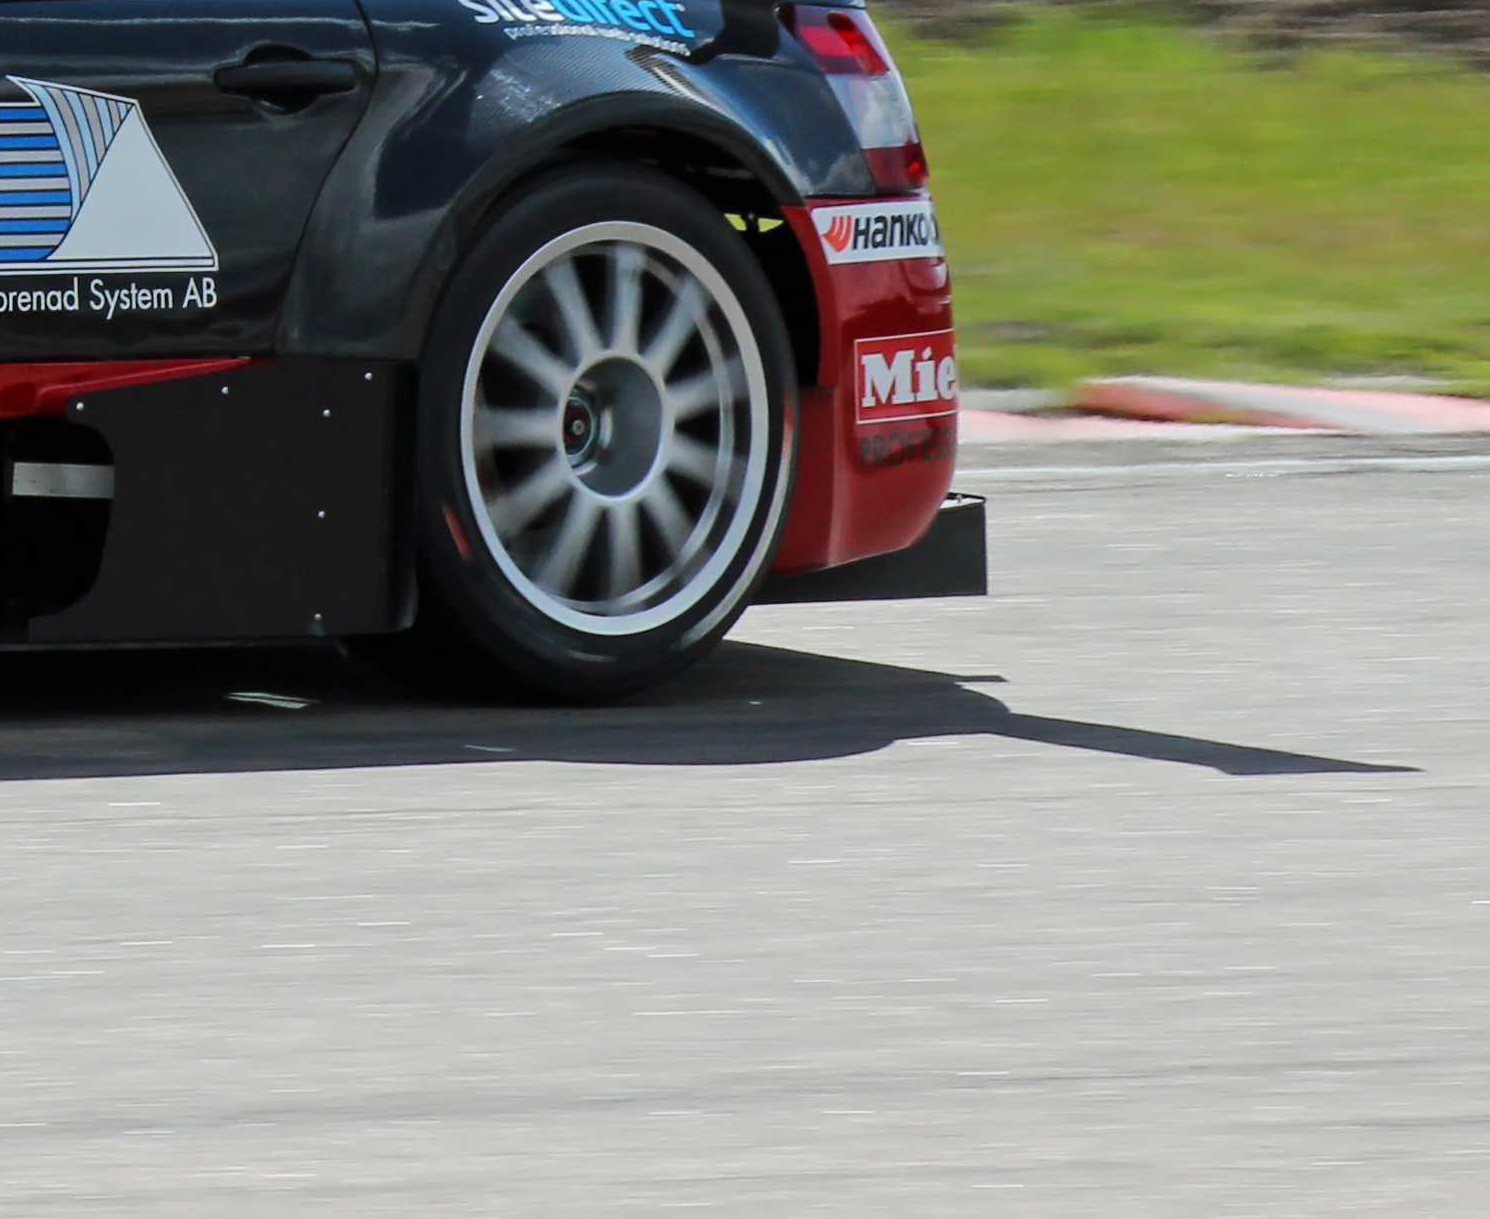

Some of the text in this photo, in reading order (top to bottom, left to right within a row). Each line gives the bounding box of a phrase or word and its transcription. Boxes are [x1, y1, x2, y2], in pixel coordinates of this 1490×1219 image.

[89, 280, 173, 319] System
[182, 278, 218, 308] AB
[861, 346, 958, 408] Mie
